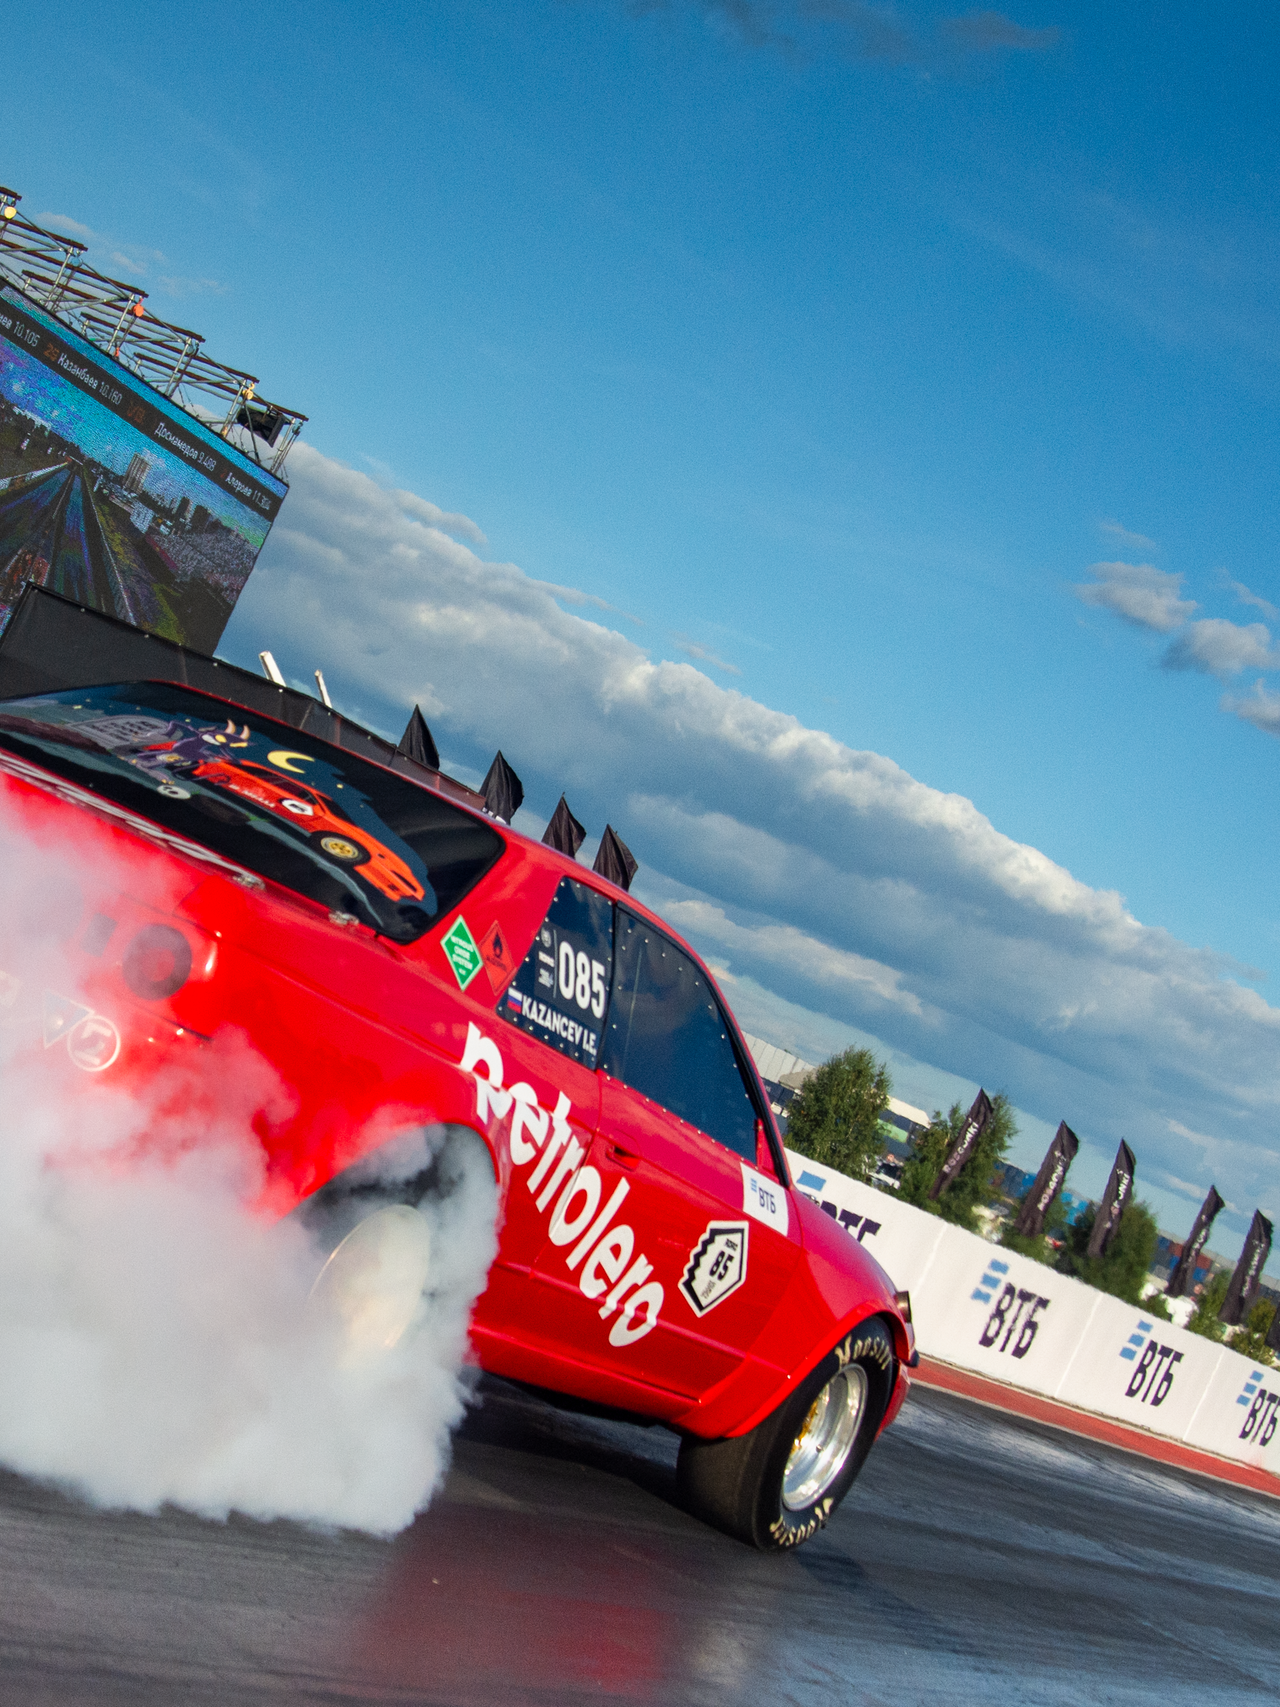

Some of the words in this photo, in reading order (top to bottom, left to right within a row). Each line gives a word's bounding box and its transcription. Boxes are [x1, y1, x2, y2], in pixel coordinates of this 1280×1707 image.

[13, 321, 41, 348] 10.105
[57, 352, 99, 389] Казанбаев
[558, 941, 606, 1019] 085
[522, 995, 584, 1045] KAZANCEV
[461, 1021, 664, 1347] Petrolero
[758, 1187, 777, 1214] ВТБ
[709, 1250, 735, 1281] 85
[978, 1281, 1051, 1360] ВТБ
[1125, 1340, 1185, 1407] ВТБ
[1238, 1388, 1280, 1447] ВТБ
